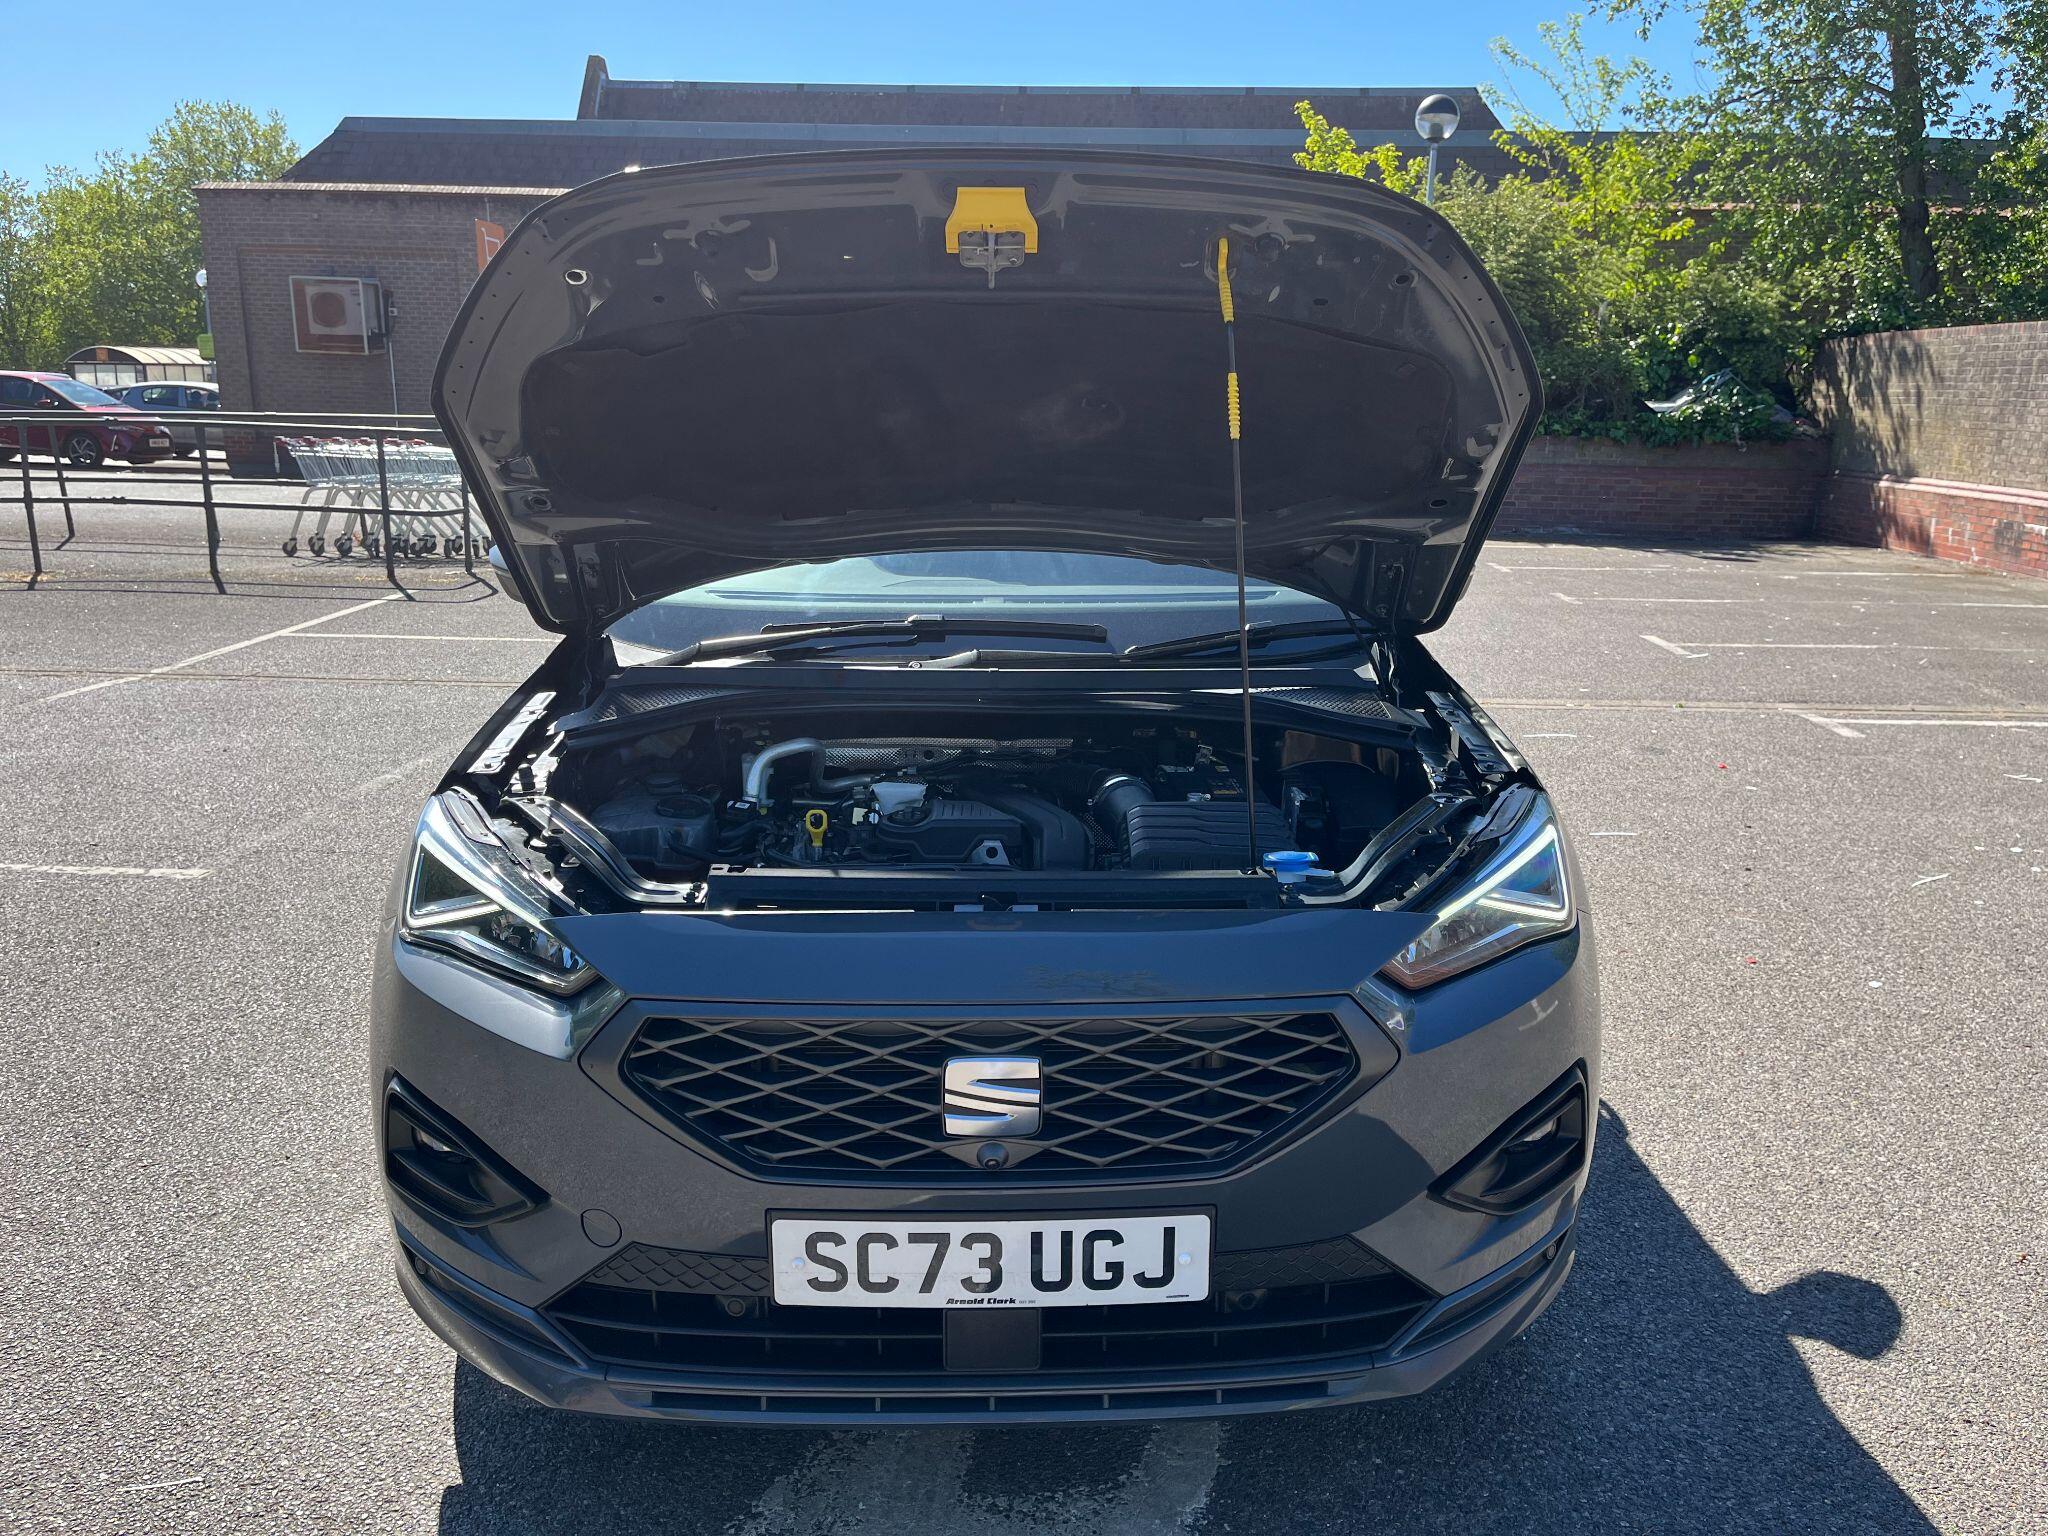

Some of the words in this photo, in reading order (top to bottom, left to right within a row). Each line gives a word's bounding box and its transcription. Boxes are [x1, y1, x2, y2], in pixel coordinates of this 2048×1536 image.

[804, 1230, 1003, 1294] SC73
[1030, 1226, 1176, 1293] UGJ
[945, 1297, 985, 1305] Arnold
[986, 1297, 1017, 1305] Clark
